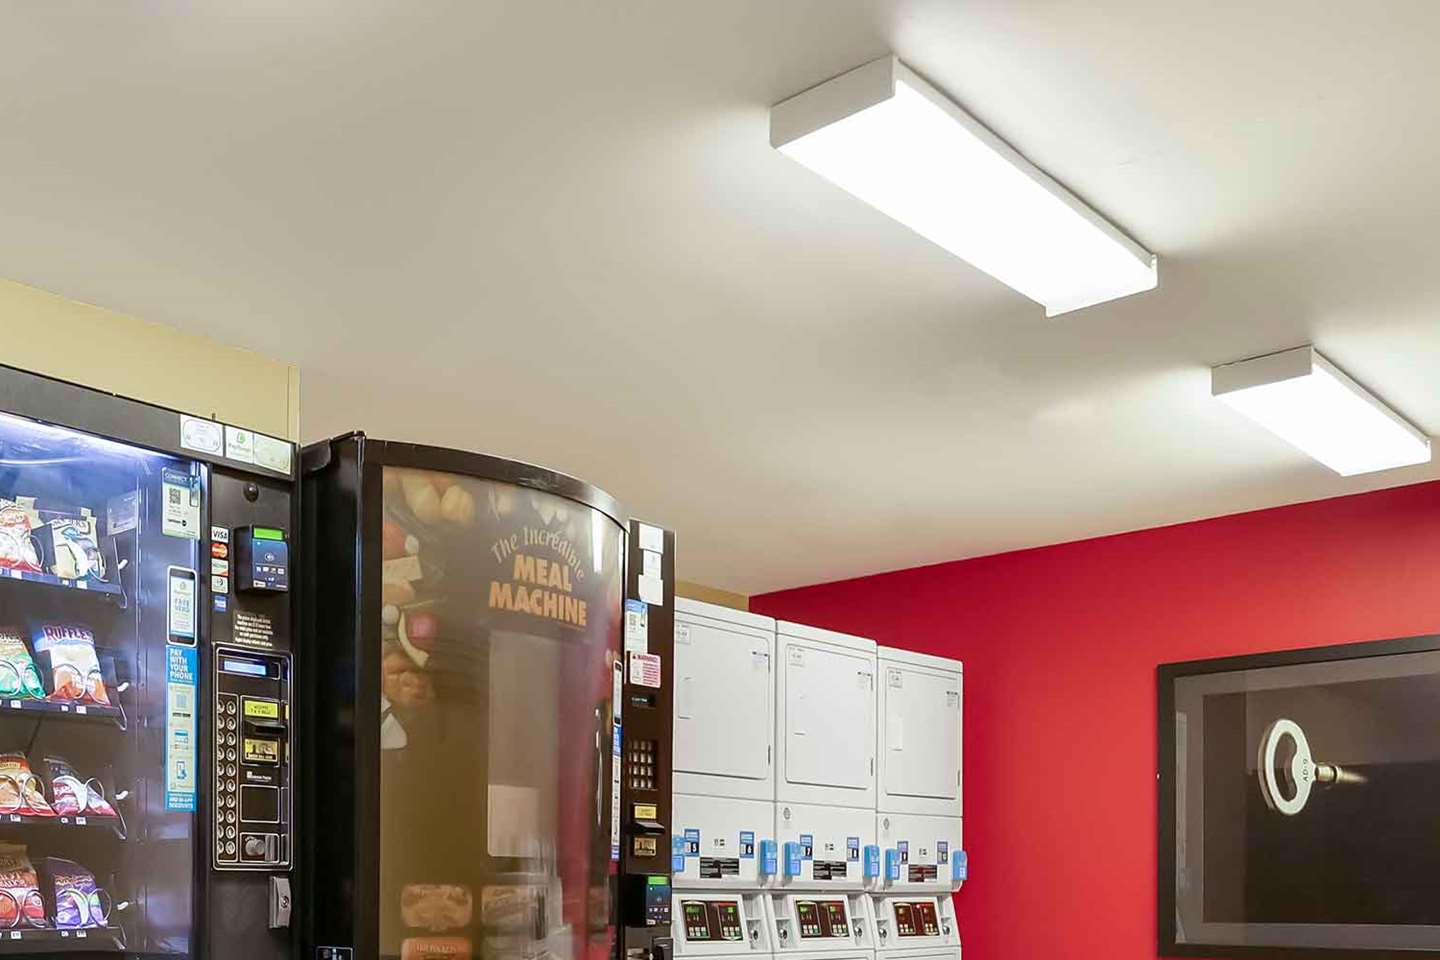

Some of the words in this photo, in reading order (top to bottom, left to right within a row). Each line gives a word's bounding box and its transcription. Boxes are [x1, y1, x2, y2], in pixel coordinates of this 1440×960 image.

[213, 531, 228, 540] VISA
[491, 534, 518, 564] The
[523, 526, 585, 582] Incredible
[514, 553, 572, 592] MEAL
[488, 581, 587, 626] MACHINE
[44, 626, 94, 641] RUFFLES
